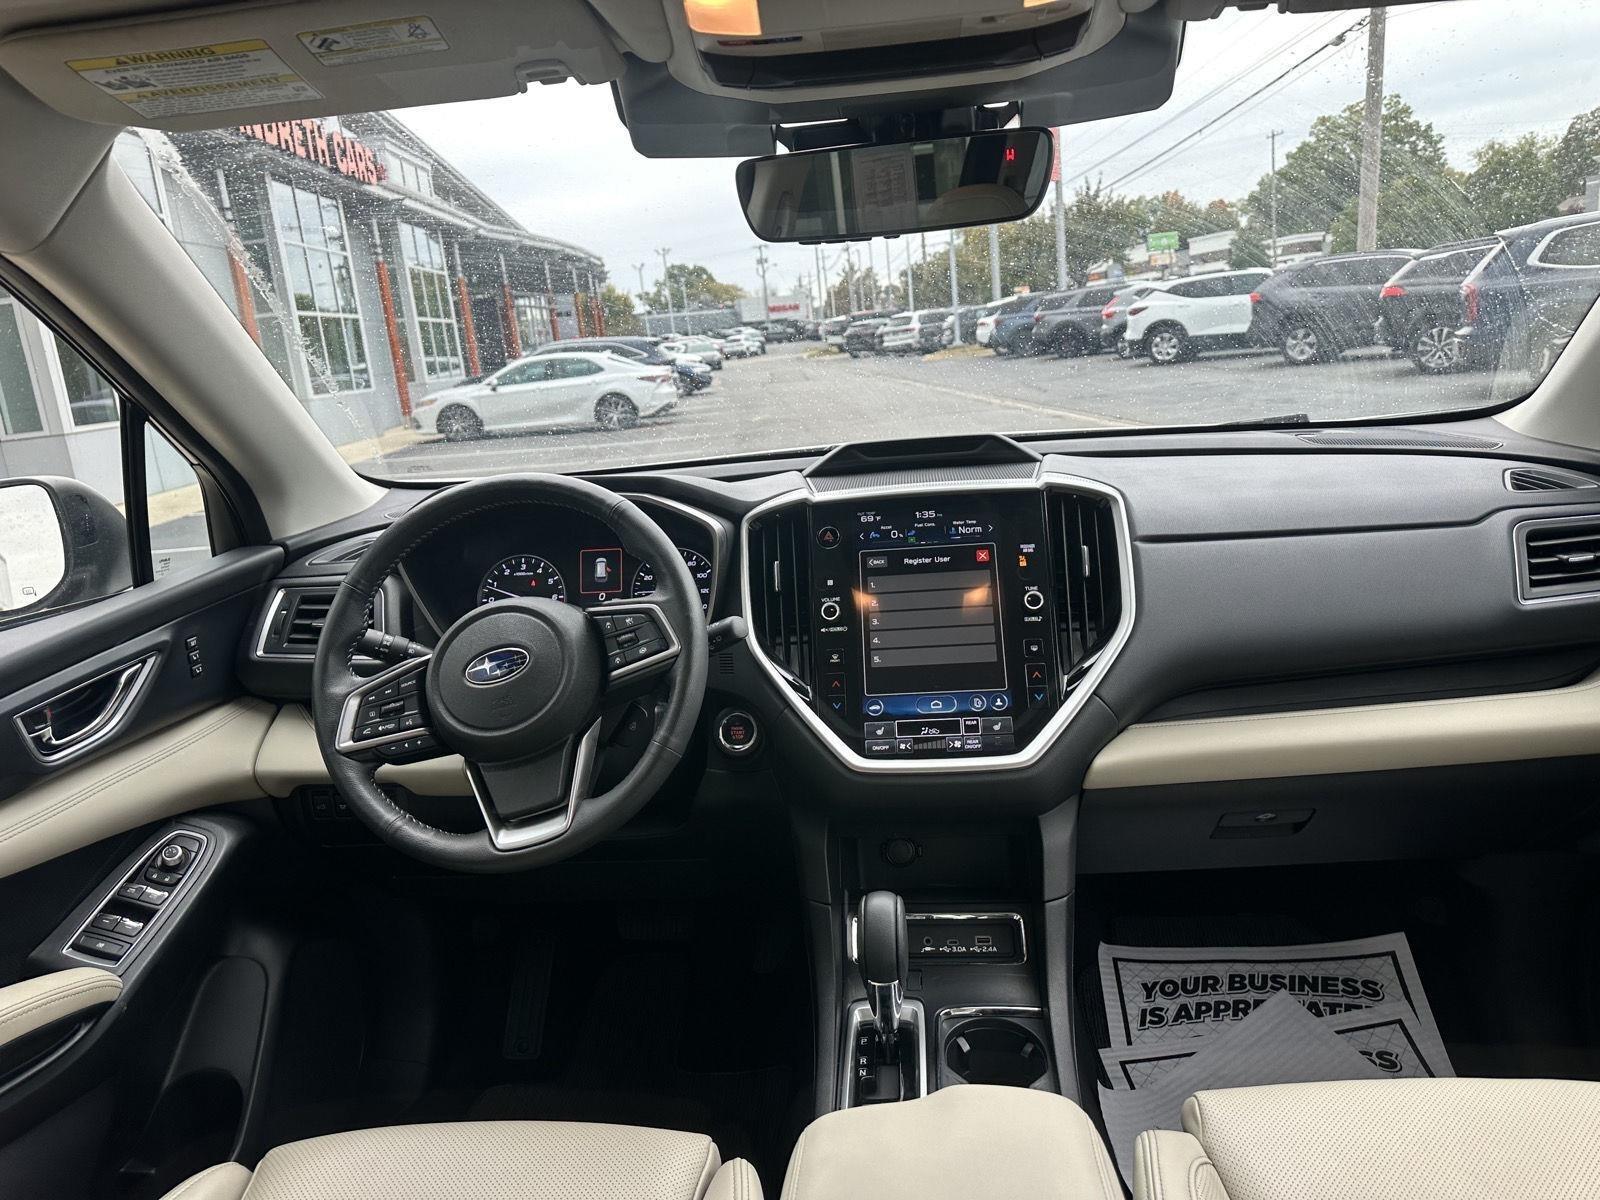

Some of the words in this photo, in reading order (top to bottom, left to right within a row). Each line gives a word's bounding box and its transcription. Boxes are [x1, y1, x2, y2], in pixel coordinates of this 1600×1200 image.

[127, 47, 216, 63] WARNING
[333, 131, 377, 185] CARS
[915, 510, 936, 519] 1:35
[958, 525, 983, 534] Norm
[890, 530, 898, 539] 0
[903, 557, 932, 566] Register
[520, 563, 527, 571] 3
[547, 577, 554, 585] 5
[1141, 974, 1221, 1000] YOUR
[1227, 972, 1384, 1000] BUSINESS
[1139, 1006, 1168, 1029] IS
